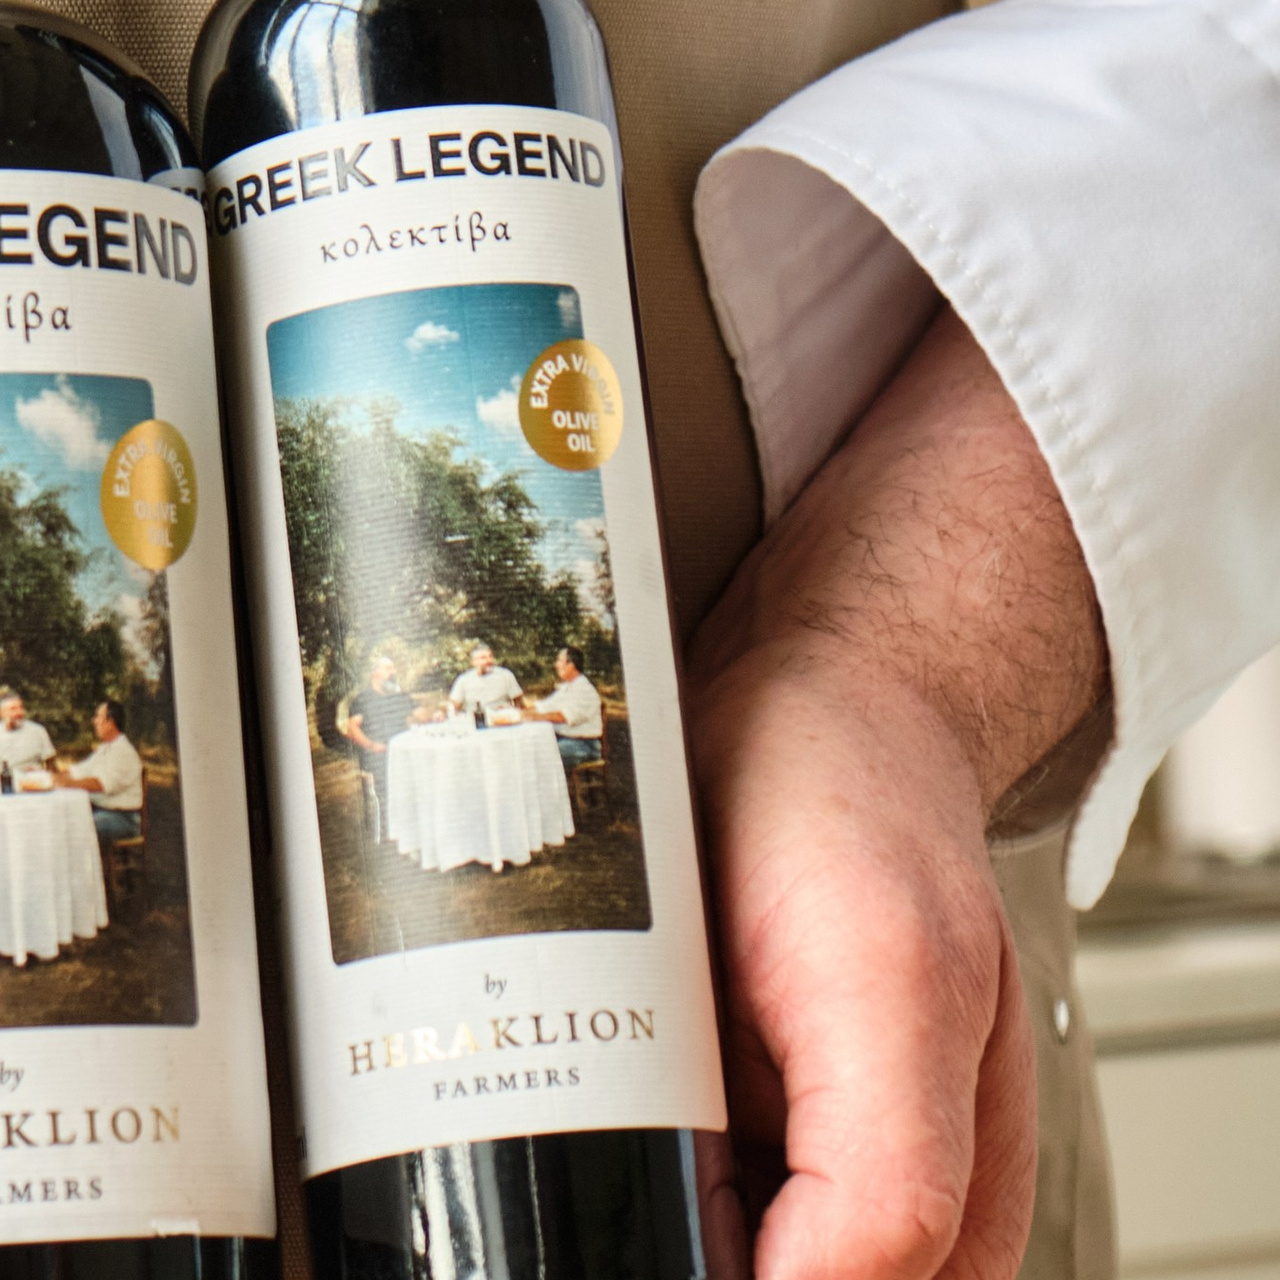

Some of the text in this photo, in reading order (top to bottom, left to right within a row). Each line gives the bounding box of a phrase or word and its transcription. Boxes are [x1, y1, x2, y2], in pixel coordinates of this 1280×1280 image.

[215, 142, 376, 236] GREEK
[390, 130, 606, 188] LEGEND
[320, 210, 511, 264] κολεκτίβα
[530, 353, 616, 415] EXTRA VIRGIN
[552, 410, 599, 431] OLIVE
[567, 433, 595, 452] OIL
[113, 439, 191, 504] EXTRA VIRGIN
[484, 974, 507, 999] by
[348, 1009, 656, 1076] HERAKLION
[434, 1067, 581, 1101] FARMERS
